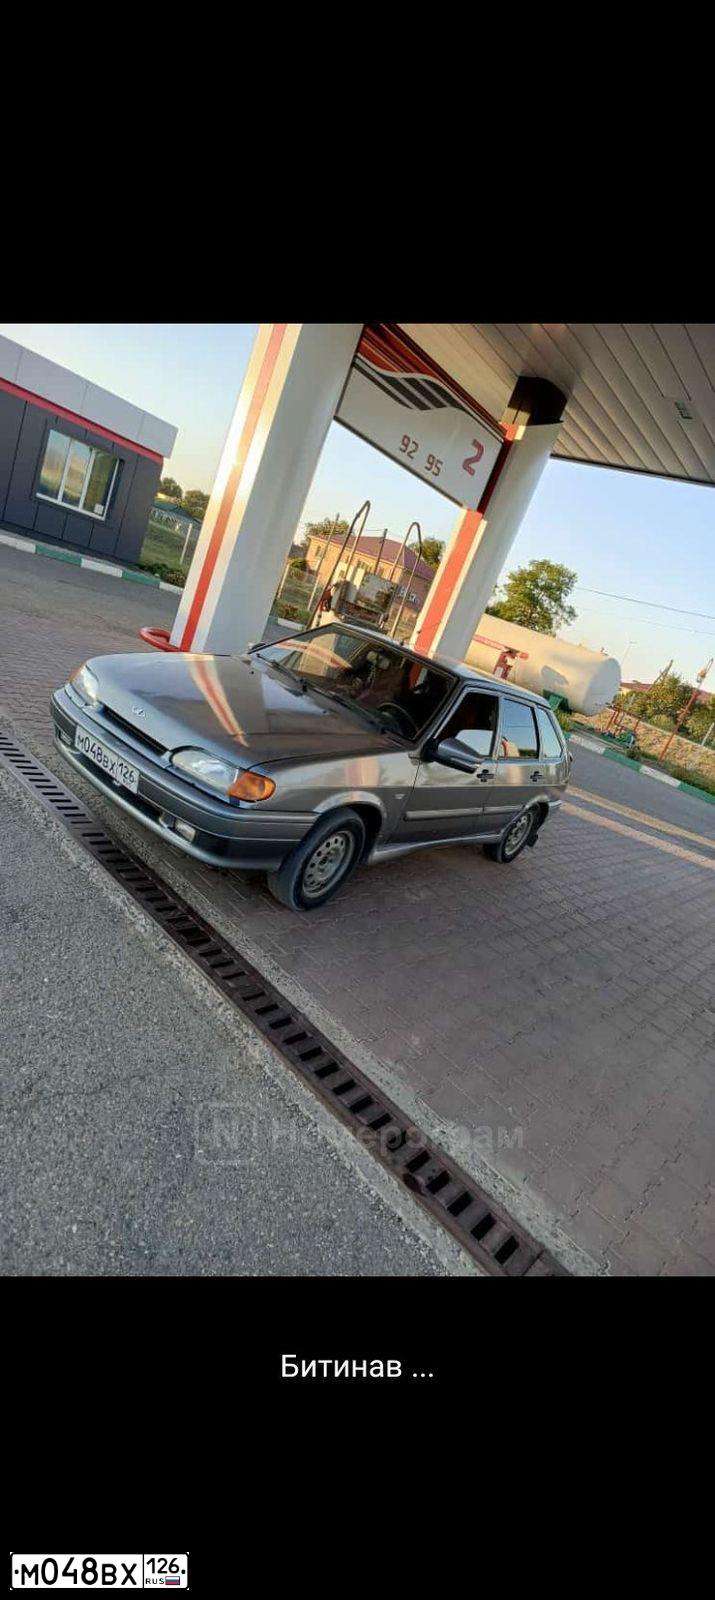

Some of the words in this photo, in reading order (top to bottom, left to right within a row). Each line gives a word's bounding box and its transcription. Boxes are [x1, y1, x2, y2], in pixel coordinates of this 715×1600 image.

[399, 434, 419, 459] 92
[424, 454, 443, 476] 95
[462, 438, 484, 476] 2
[118, 762, 136, 784] 126
